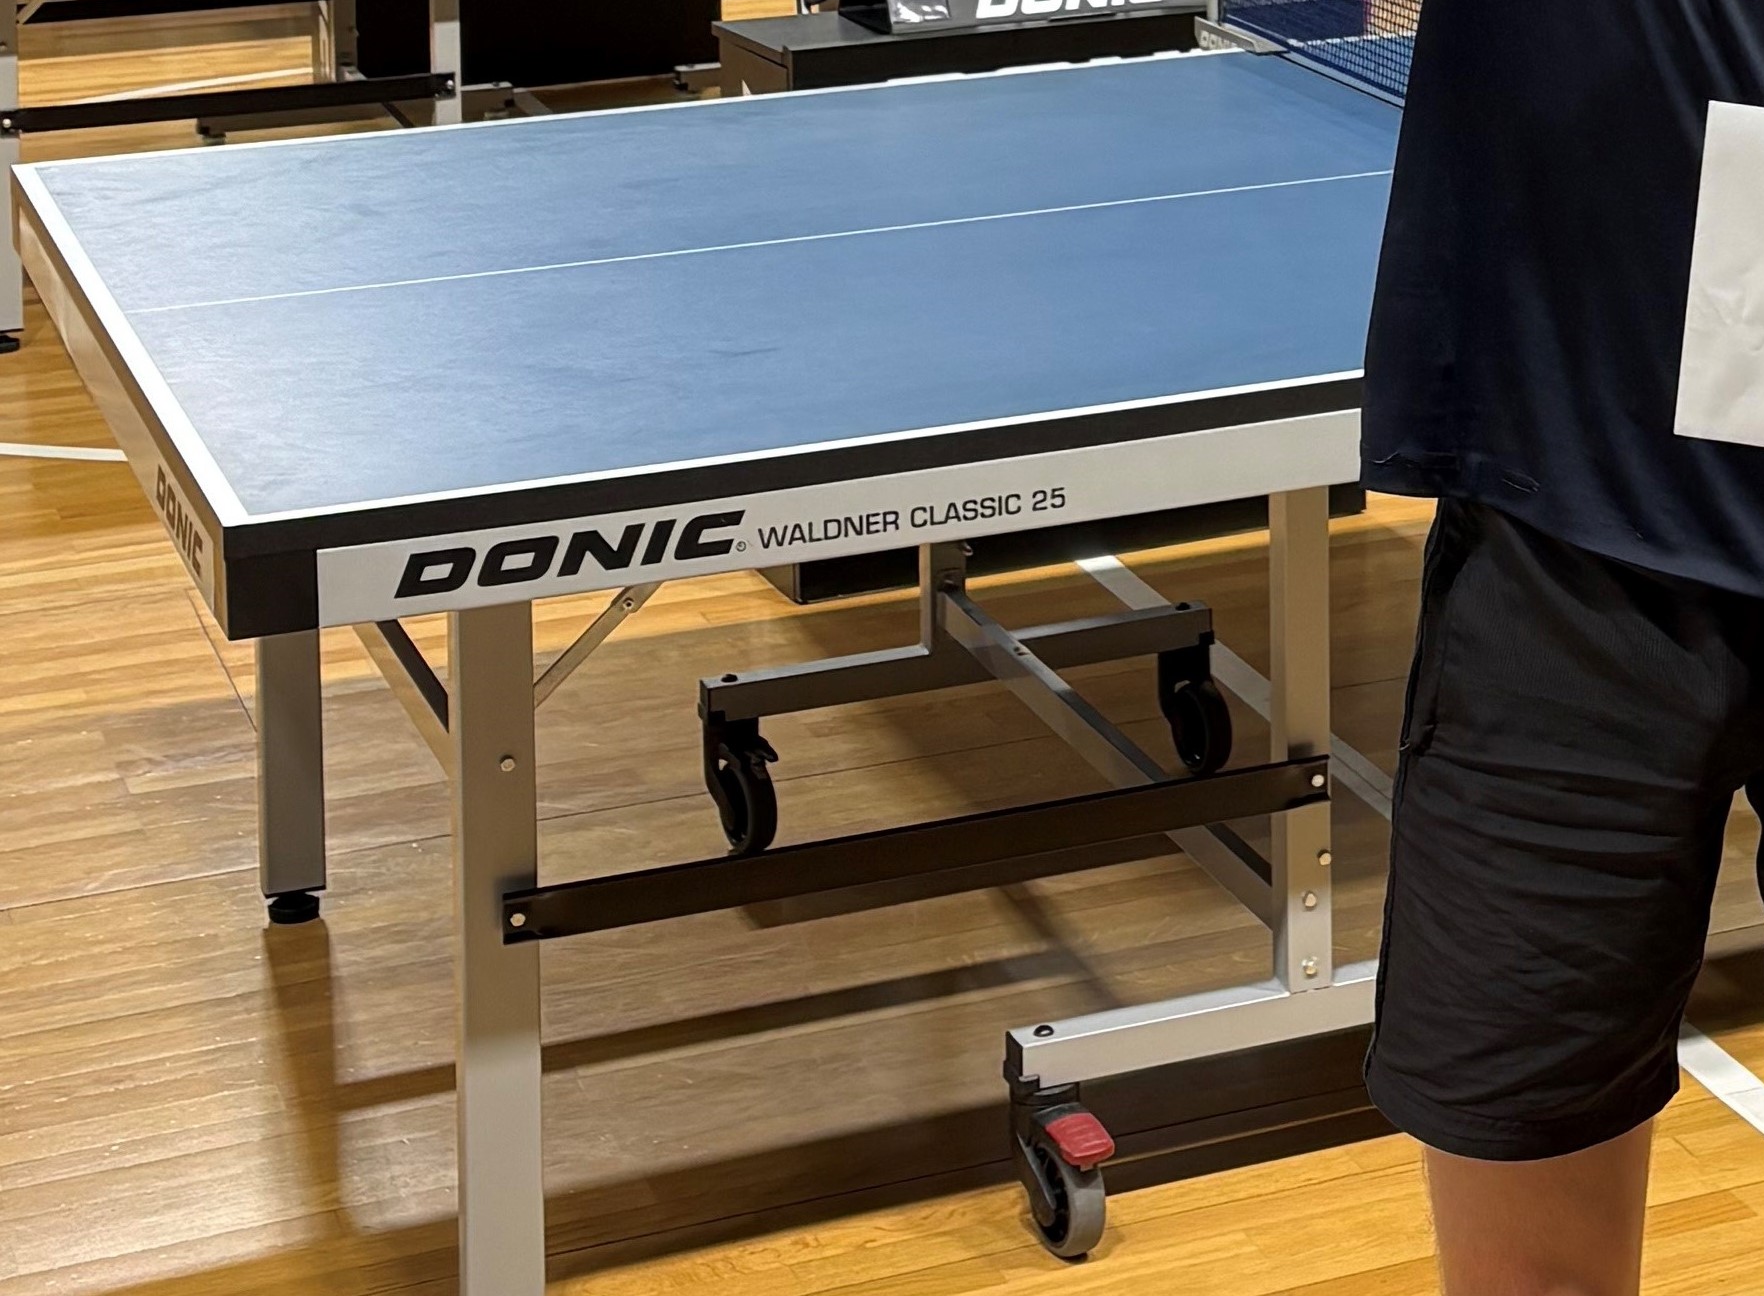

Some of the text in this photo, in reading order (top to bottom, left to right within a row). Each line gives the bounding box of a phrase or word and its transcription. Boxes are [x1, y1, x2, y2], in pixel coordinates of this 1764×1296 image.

[156, 463, 204, 581] DONIC
[394, 487, 1067, 599] DONIC WALDNER CLASSIC 25
